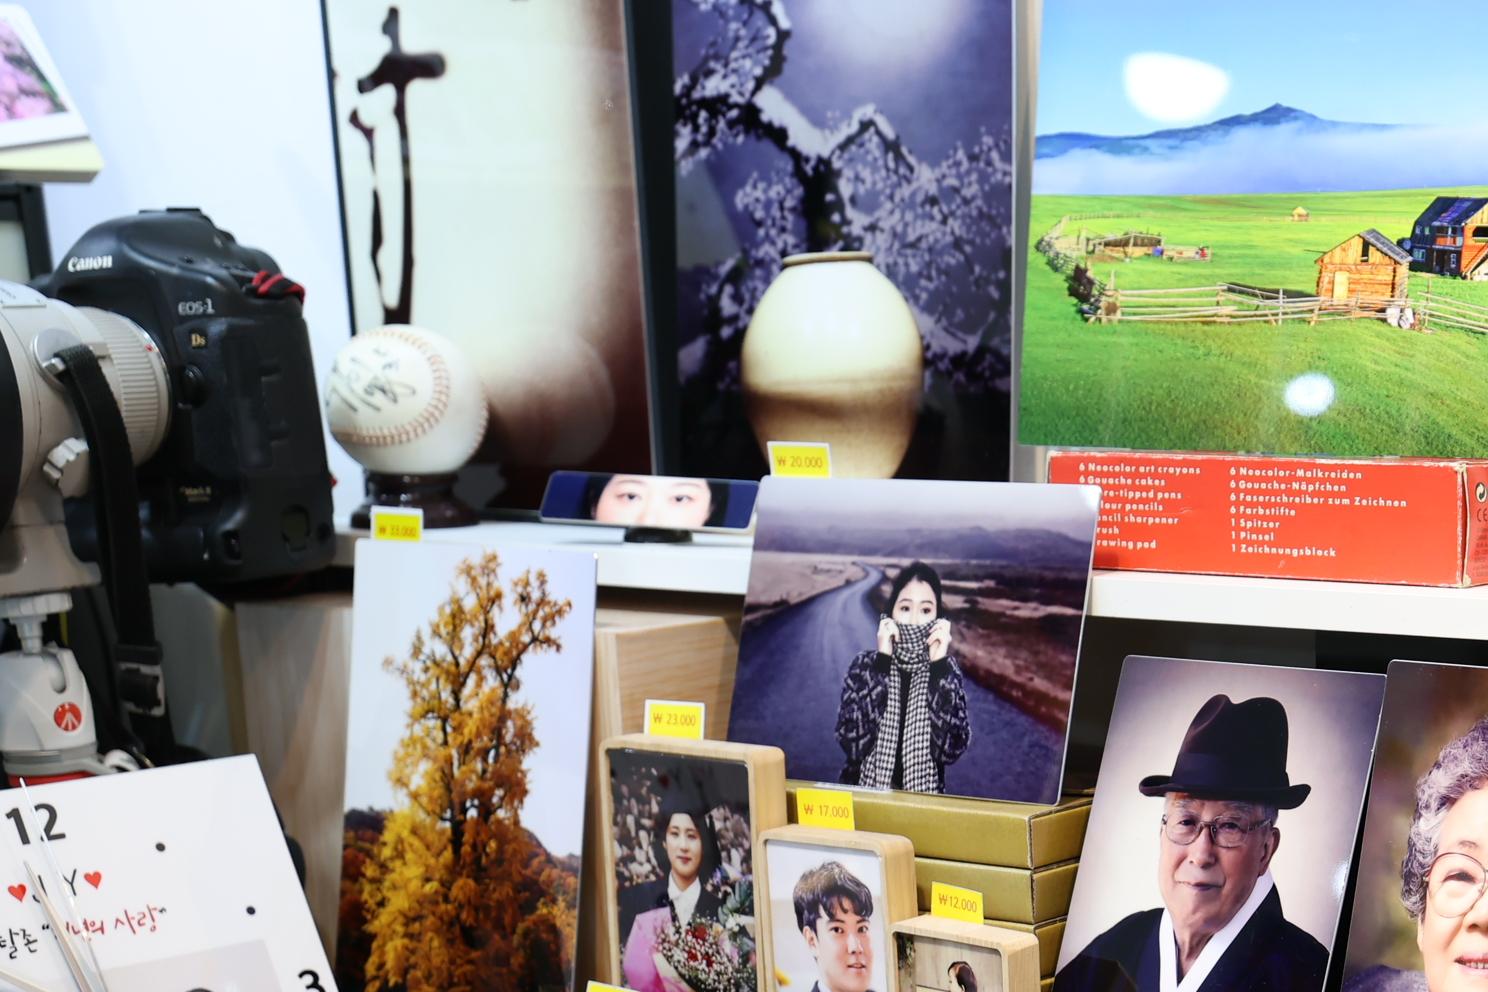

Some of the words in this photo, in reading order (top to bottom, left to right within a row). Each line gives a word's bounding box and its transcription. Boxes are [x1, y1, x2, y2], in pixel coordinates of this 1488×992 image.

[67, 255, 113, 273] Canon
[178, 298, 215, 315] EOS-1
[1079, 463, 1085, 472] 6
[1087, 463, 1136, 473] Neocolor
[1139, 464, 1155, 473] art
[1158, 465, 1200, 475] crayons
[1230, 467, 1236, 476] 6
[1239, 467, 1362, 480] Neocolor-Malkreiden
[1079, 475, 1085, 484] 6
[1087, 475, 1133, 486] Gouache
[1135, 477, 1165, 487] cakes
[1230, 480, 1236, 489] 6
[1238, 480, 1347, 492] Gouache-Näpfchen
[1104, 489, 1154, 499] re-tipped
[1157, 490, 1182, 500] pens
[1230, 493, 1236, 501] 6
[1239, 492, 1324, 505] Faserschreiber
[1328, 497, 1350, 505] zum
[1354, 496, 1407, 507] Zeichnen
[1100, 500, 1122, 510] lour
[1125, 502, 1163, 512] pencils
[1230, 506, 1236, 514] 6
[1239, 506, 1296, 517] Farbstifte
[1098, 513, 1121, 522] ncil
[1124, 514, 1179, 525] sharpener
[1231, 518, 1236, 527] 1
[1239, 518, 1280, 529] Spitzer
[1096, 526, 1119, 535] rush
[1231, 531, 1236, 540] 1
[1239, 531, 1274, 541] Pinsel
[1096, 538, 1133, 549] rawing
[1137, 539, 1156, 549] pad
[1231, 544, 1236, 552] 1
[1240, 544, 1337, 557] Zeichnungsblock
[5, 803, 66, 845] 12
